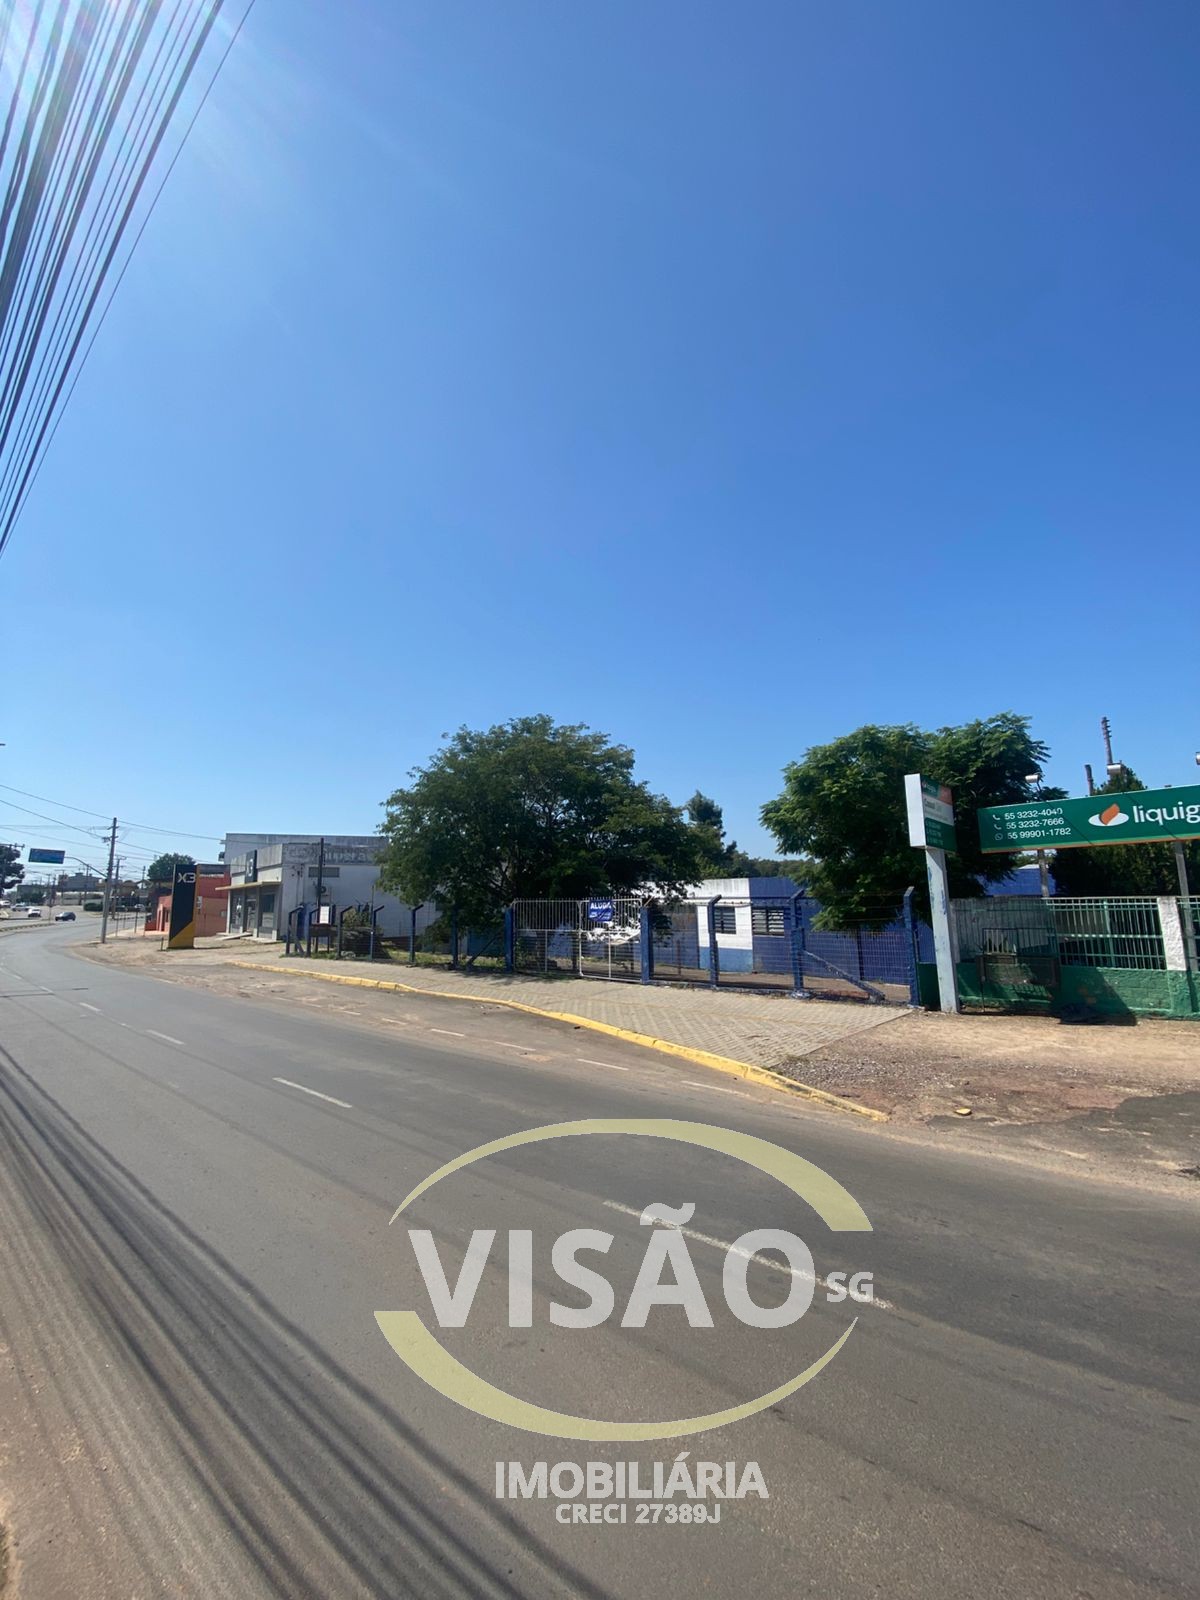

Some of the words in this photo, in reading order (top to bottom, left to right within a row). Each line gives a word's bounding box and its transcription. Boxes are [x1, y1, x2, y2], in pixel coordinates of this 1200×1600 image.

[1004, 812, 1016, 820] 55
[1017, 807, 1063, 819] 3232-4040
[1132, 800, 1200, 826] liquig
[1006, 822, 1017, 830] 55
[1018, 817, 1065, 829] 3232-7666
[1008, 832, 1018, 840] 55
[1019, 827, 1072, 839] 99901-1782
[177, 872, 196, 884] X3
